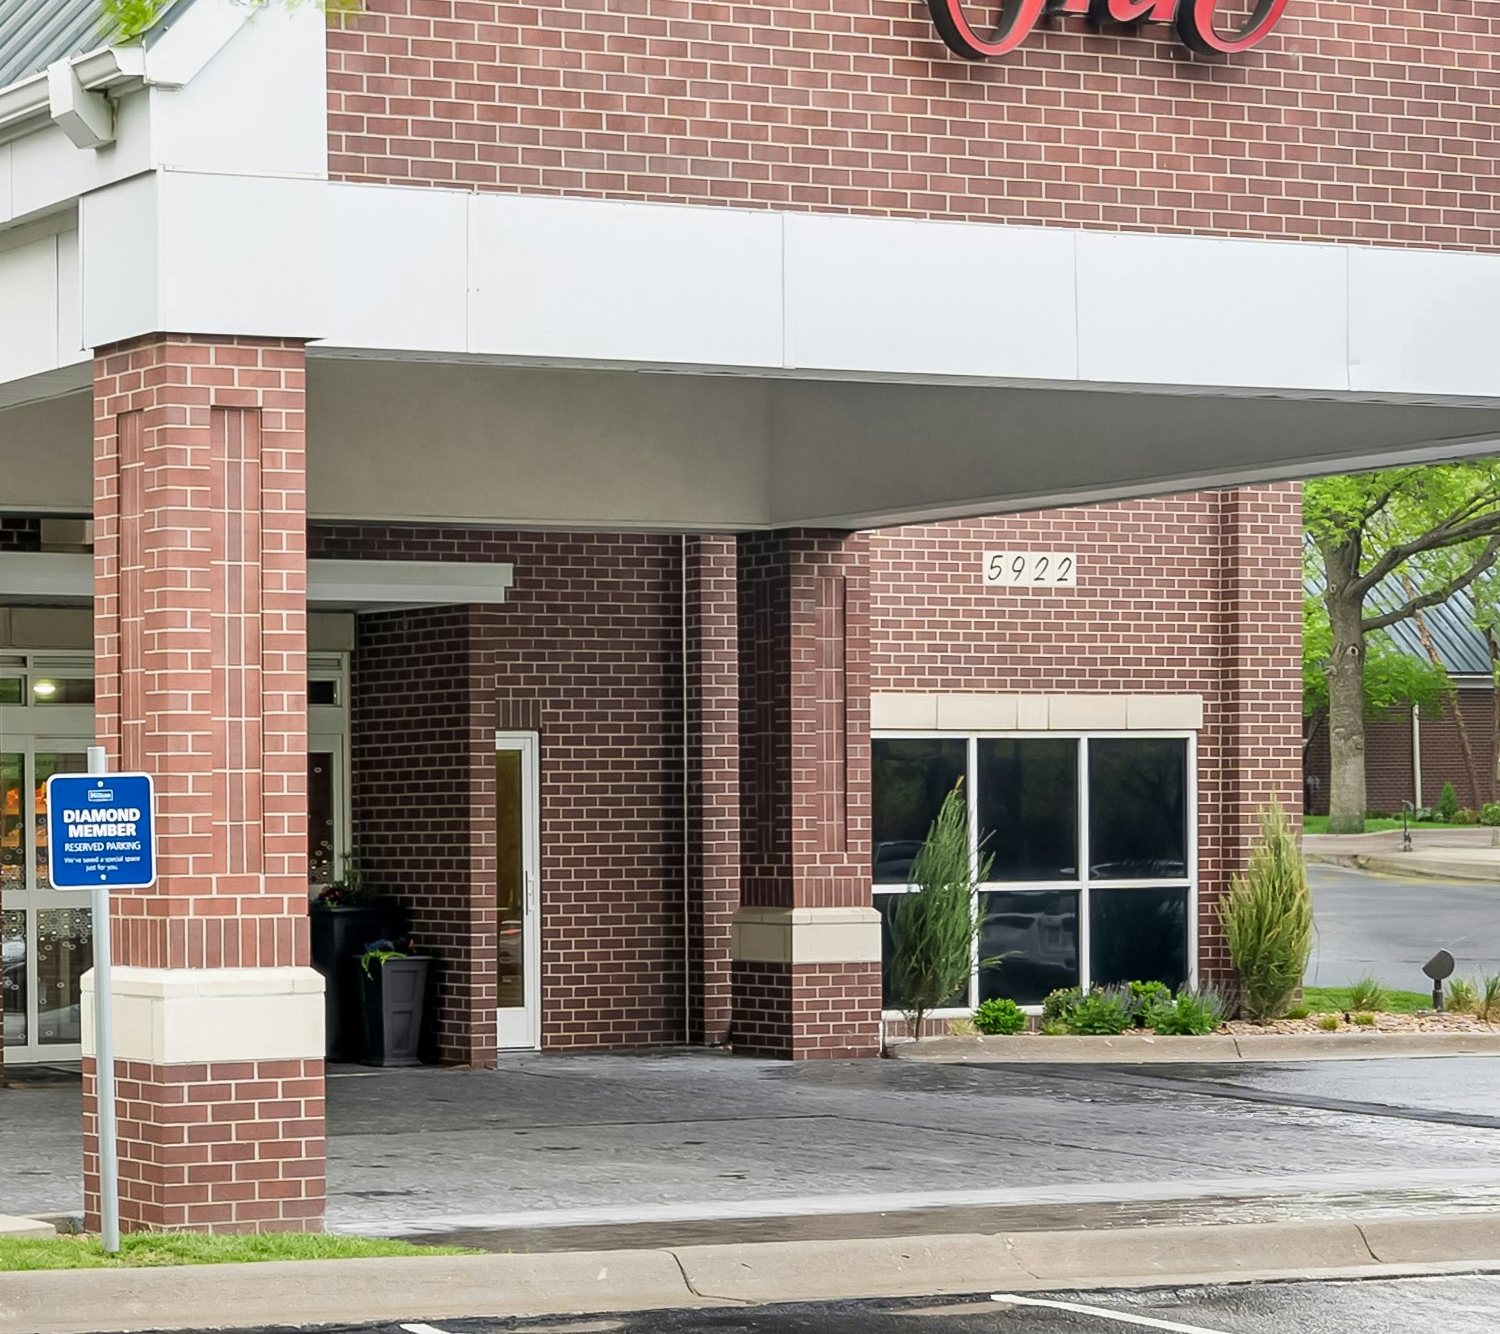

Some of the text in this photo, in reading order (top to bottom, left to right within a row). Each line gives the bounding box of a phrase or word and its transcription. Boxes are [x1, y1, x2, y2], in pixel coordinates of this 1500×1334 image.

[987, 554, 1073, 581] 5922
[63, 808, 140, 823] DIAMOND
[68, 823, 136, 838] MEMBER
[64, 841, 141, 852] RESERVED PARKING
